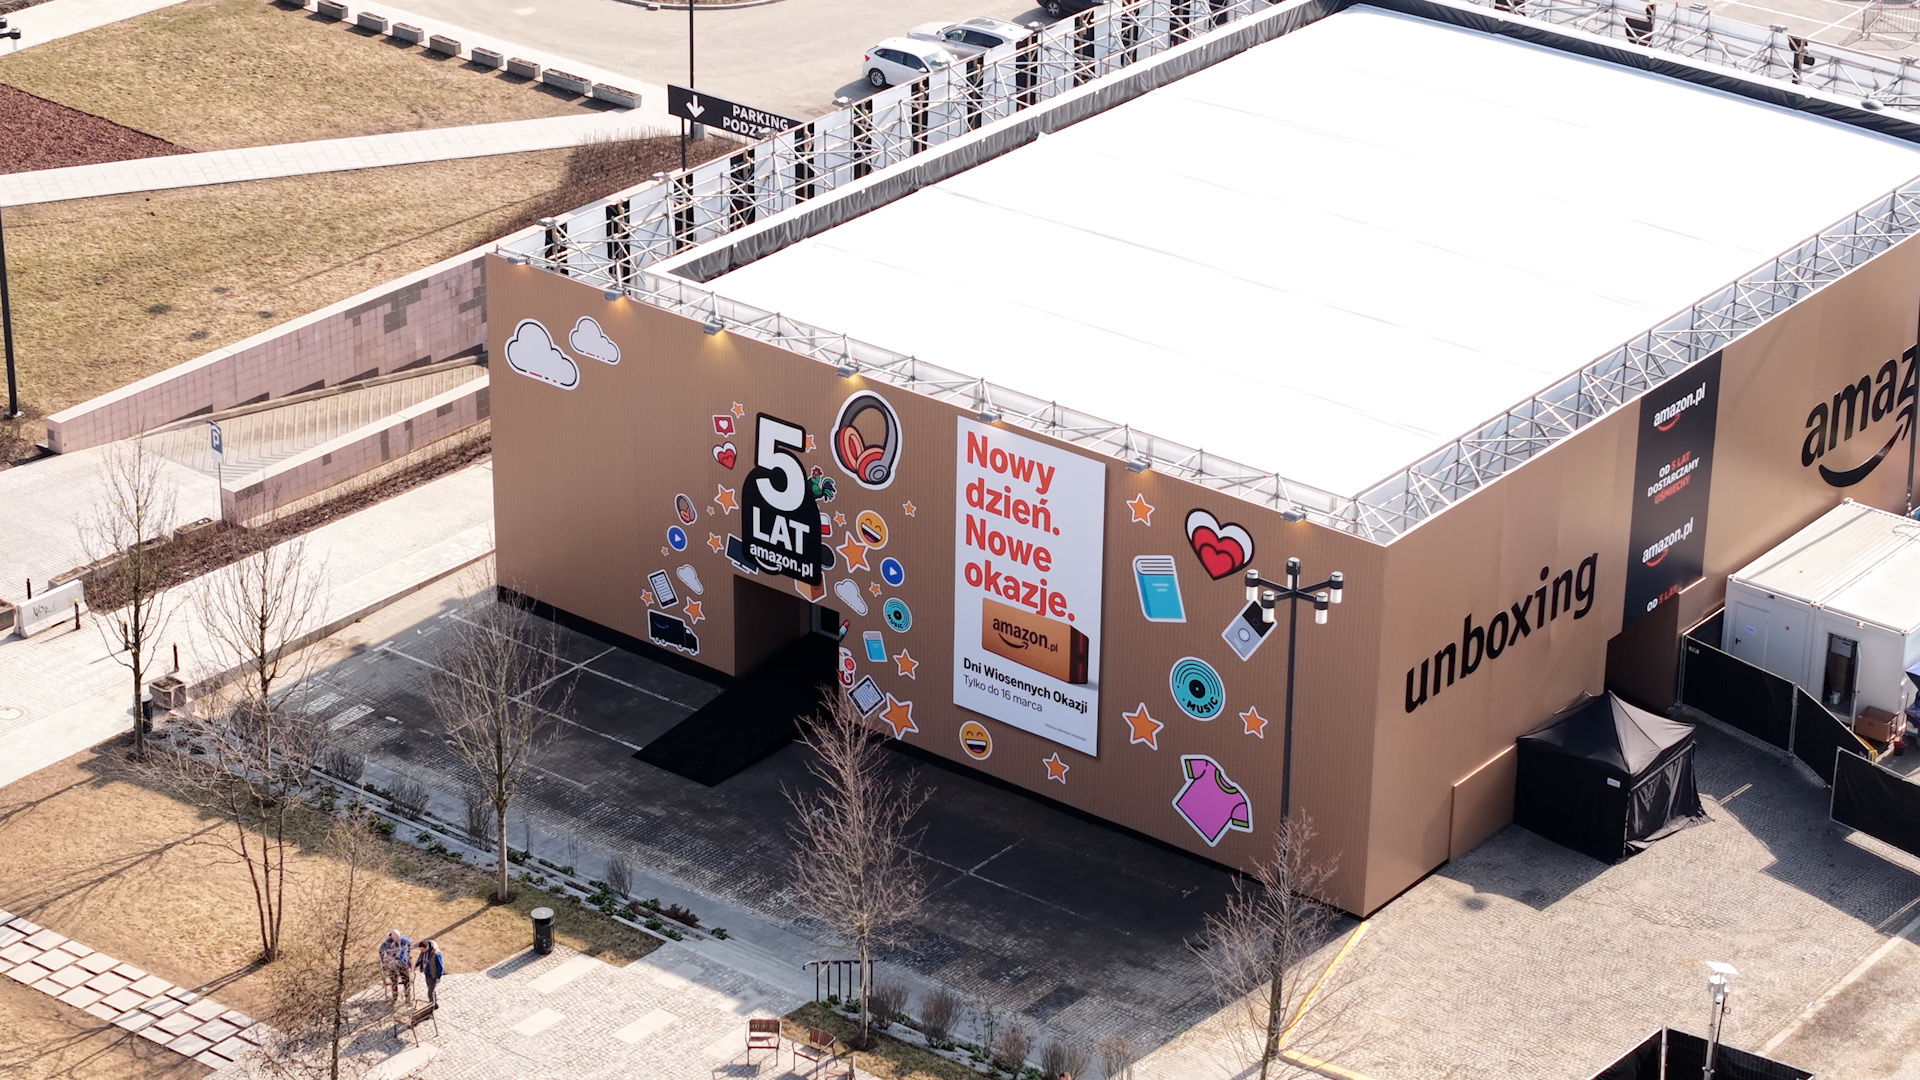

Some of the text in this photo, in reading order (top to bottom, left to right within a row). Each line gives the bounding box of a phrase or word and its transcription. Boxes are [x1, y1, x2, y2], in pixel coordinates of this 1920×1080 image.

[732, 105, 789, 130] PARKING
[1653, 382, 1706, 427] amazon.pl
[755, 417, 806, 512] 5
[967, 431, 1055, 495] Nowy
[1647, 457, 1700, 498] DOSTARCZAMY
[1659, 450, 1691, 478] OD 5 LAT
[965, 477, 1060, 536] dzień.
[1653, 474, 1691, 505] UŚMIECHY
[752, 506, 810, 556] LAT
[965, 513, 1052, 572] Nowe
[1642, 516, 1694, 564] amazon.pl
[750, 543, 814, 577] amazon.pl
[964, 559, 1076, 622] okazje.
[1646, 598, 1658, 612] OD
[1664, 584, 1678, 600] LAT
[887, 613, 904, 629] MUSIC
[992, 618, 1058, 653] amazon.pl
[1405, 552, 1599, 714] unboxing
[963, 657, 1088, 714] Dni Wiosennych Okazji
[963, 674, 1043, 712] Tylko do 16 marca
[1186, 696, 1218, 714] MUSIC
